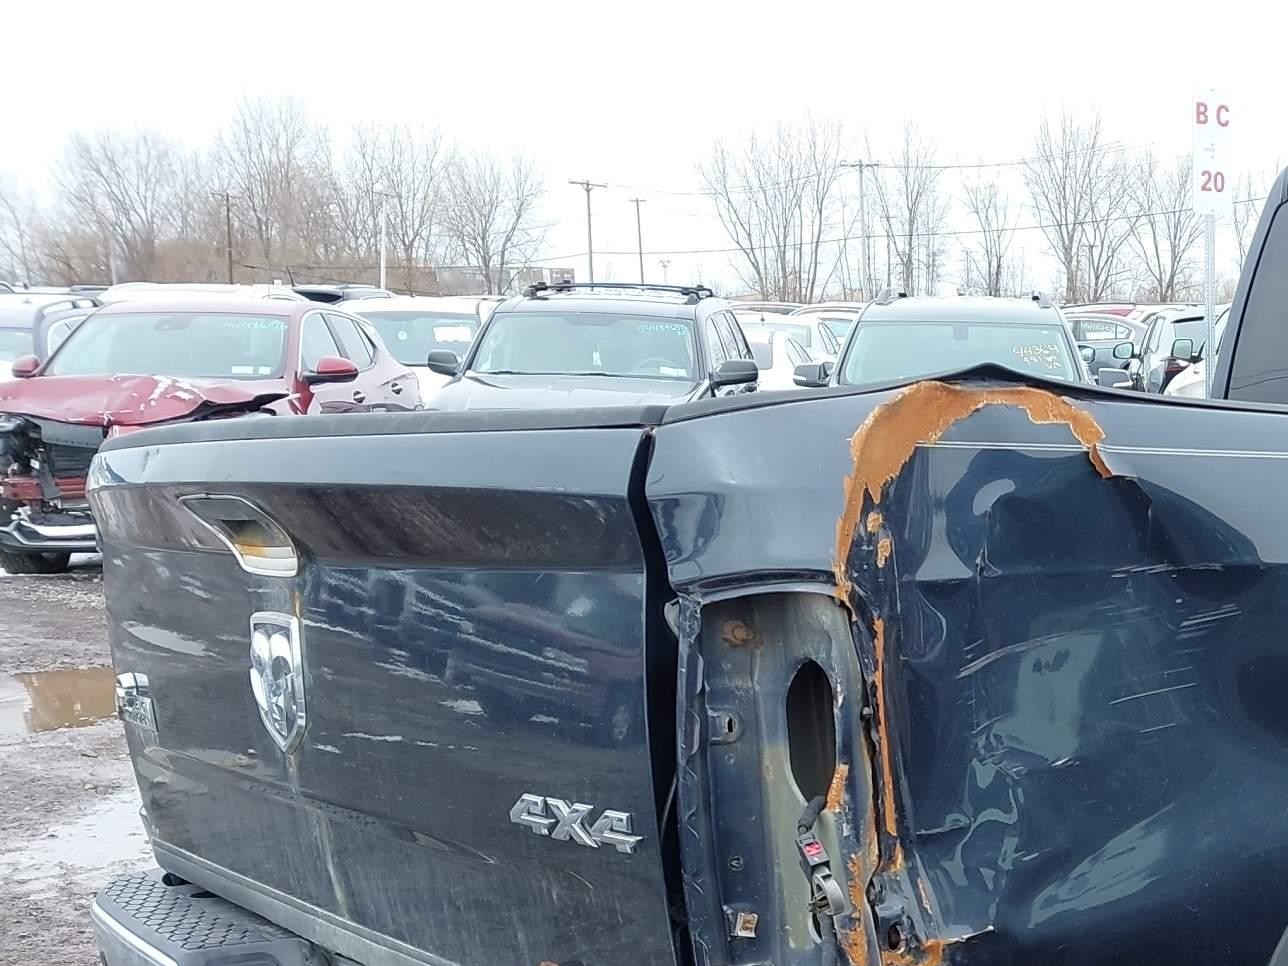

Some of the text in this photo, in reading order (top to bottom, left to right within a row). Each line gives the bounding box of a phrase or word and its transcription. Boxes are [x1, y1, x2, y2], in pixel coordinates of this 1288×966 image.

[1196, 101, 1230, 127] B C
[1200, 170, 1225, 192] 20
